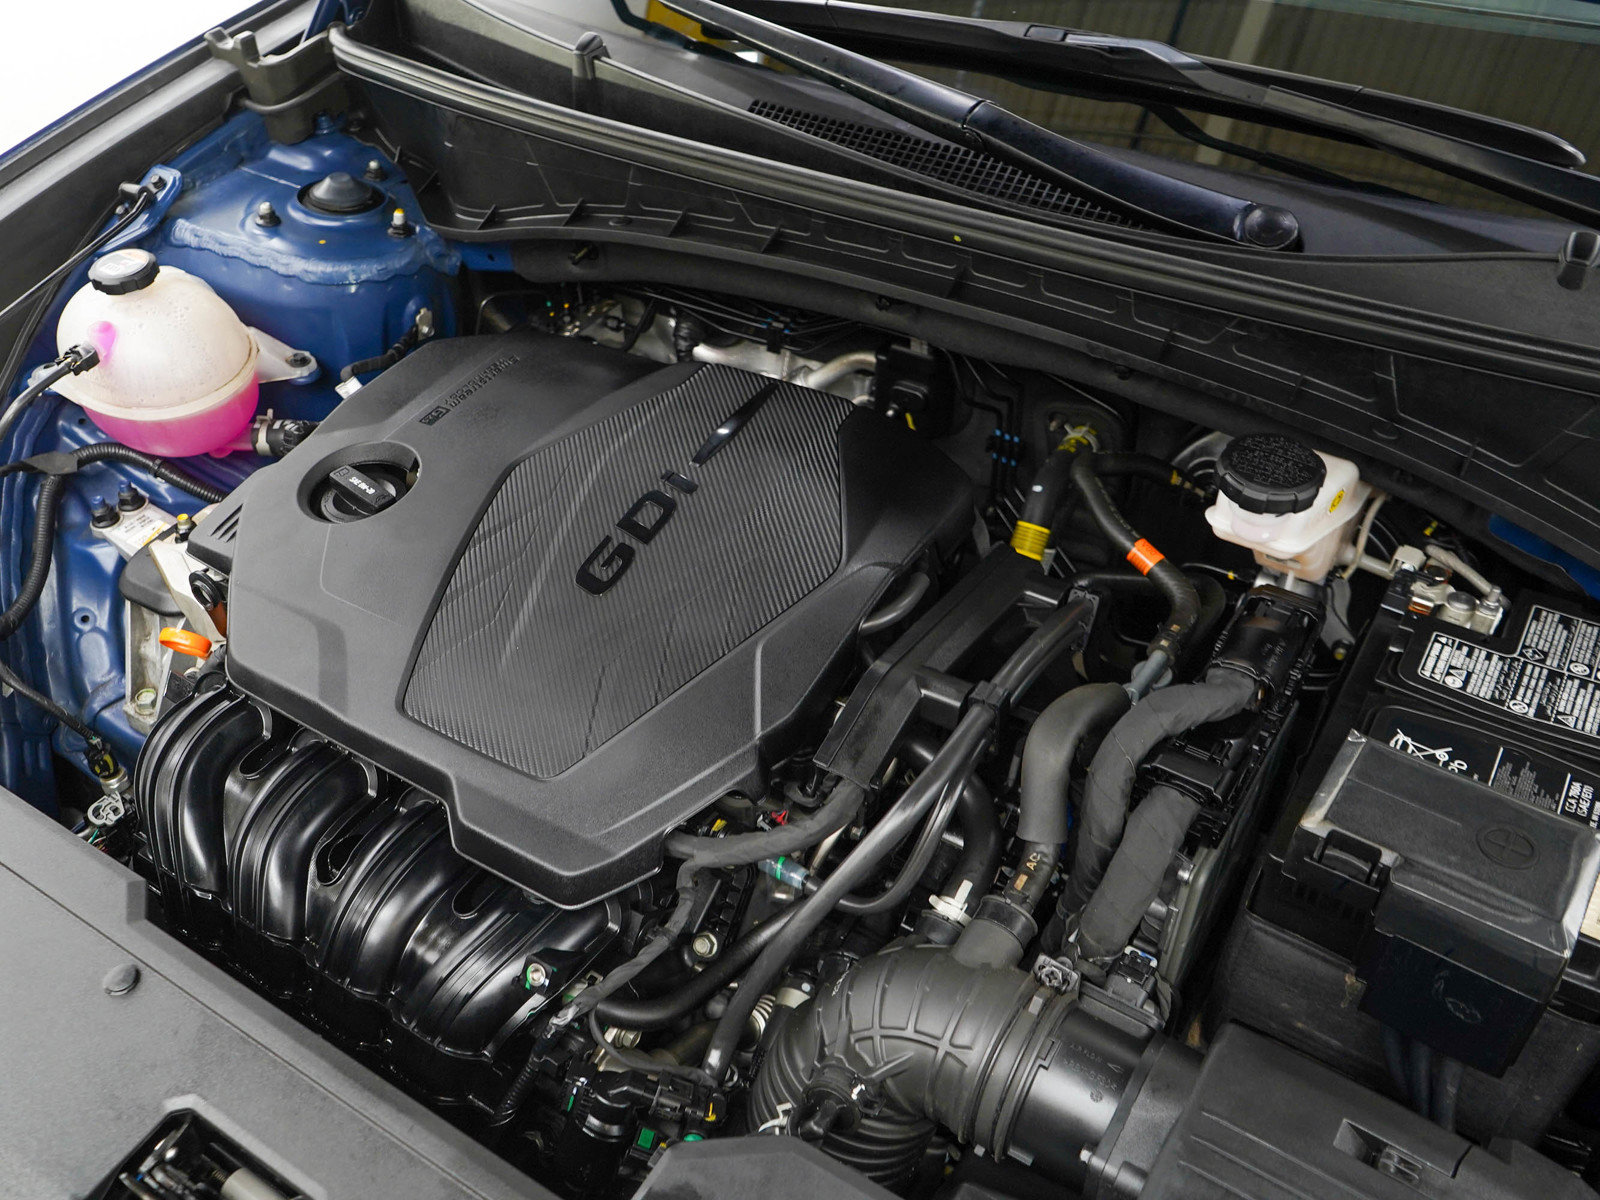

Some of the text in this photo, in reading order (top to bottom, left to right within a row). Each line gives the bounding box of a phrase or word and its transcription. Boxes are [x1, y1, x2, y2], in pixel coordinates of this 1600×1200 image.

[449, 354, 520, 408] Smartstream
[1565, 798, 1578, 813] CCA
[1026, 852, 1041, 871] AC
